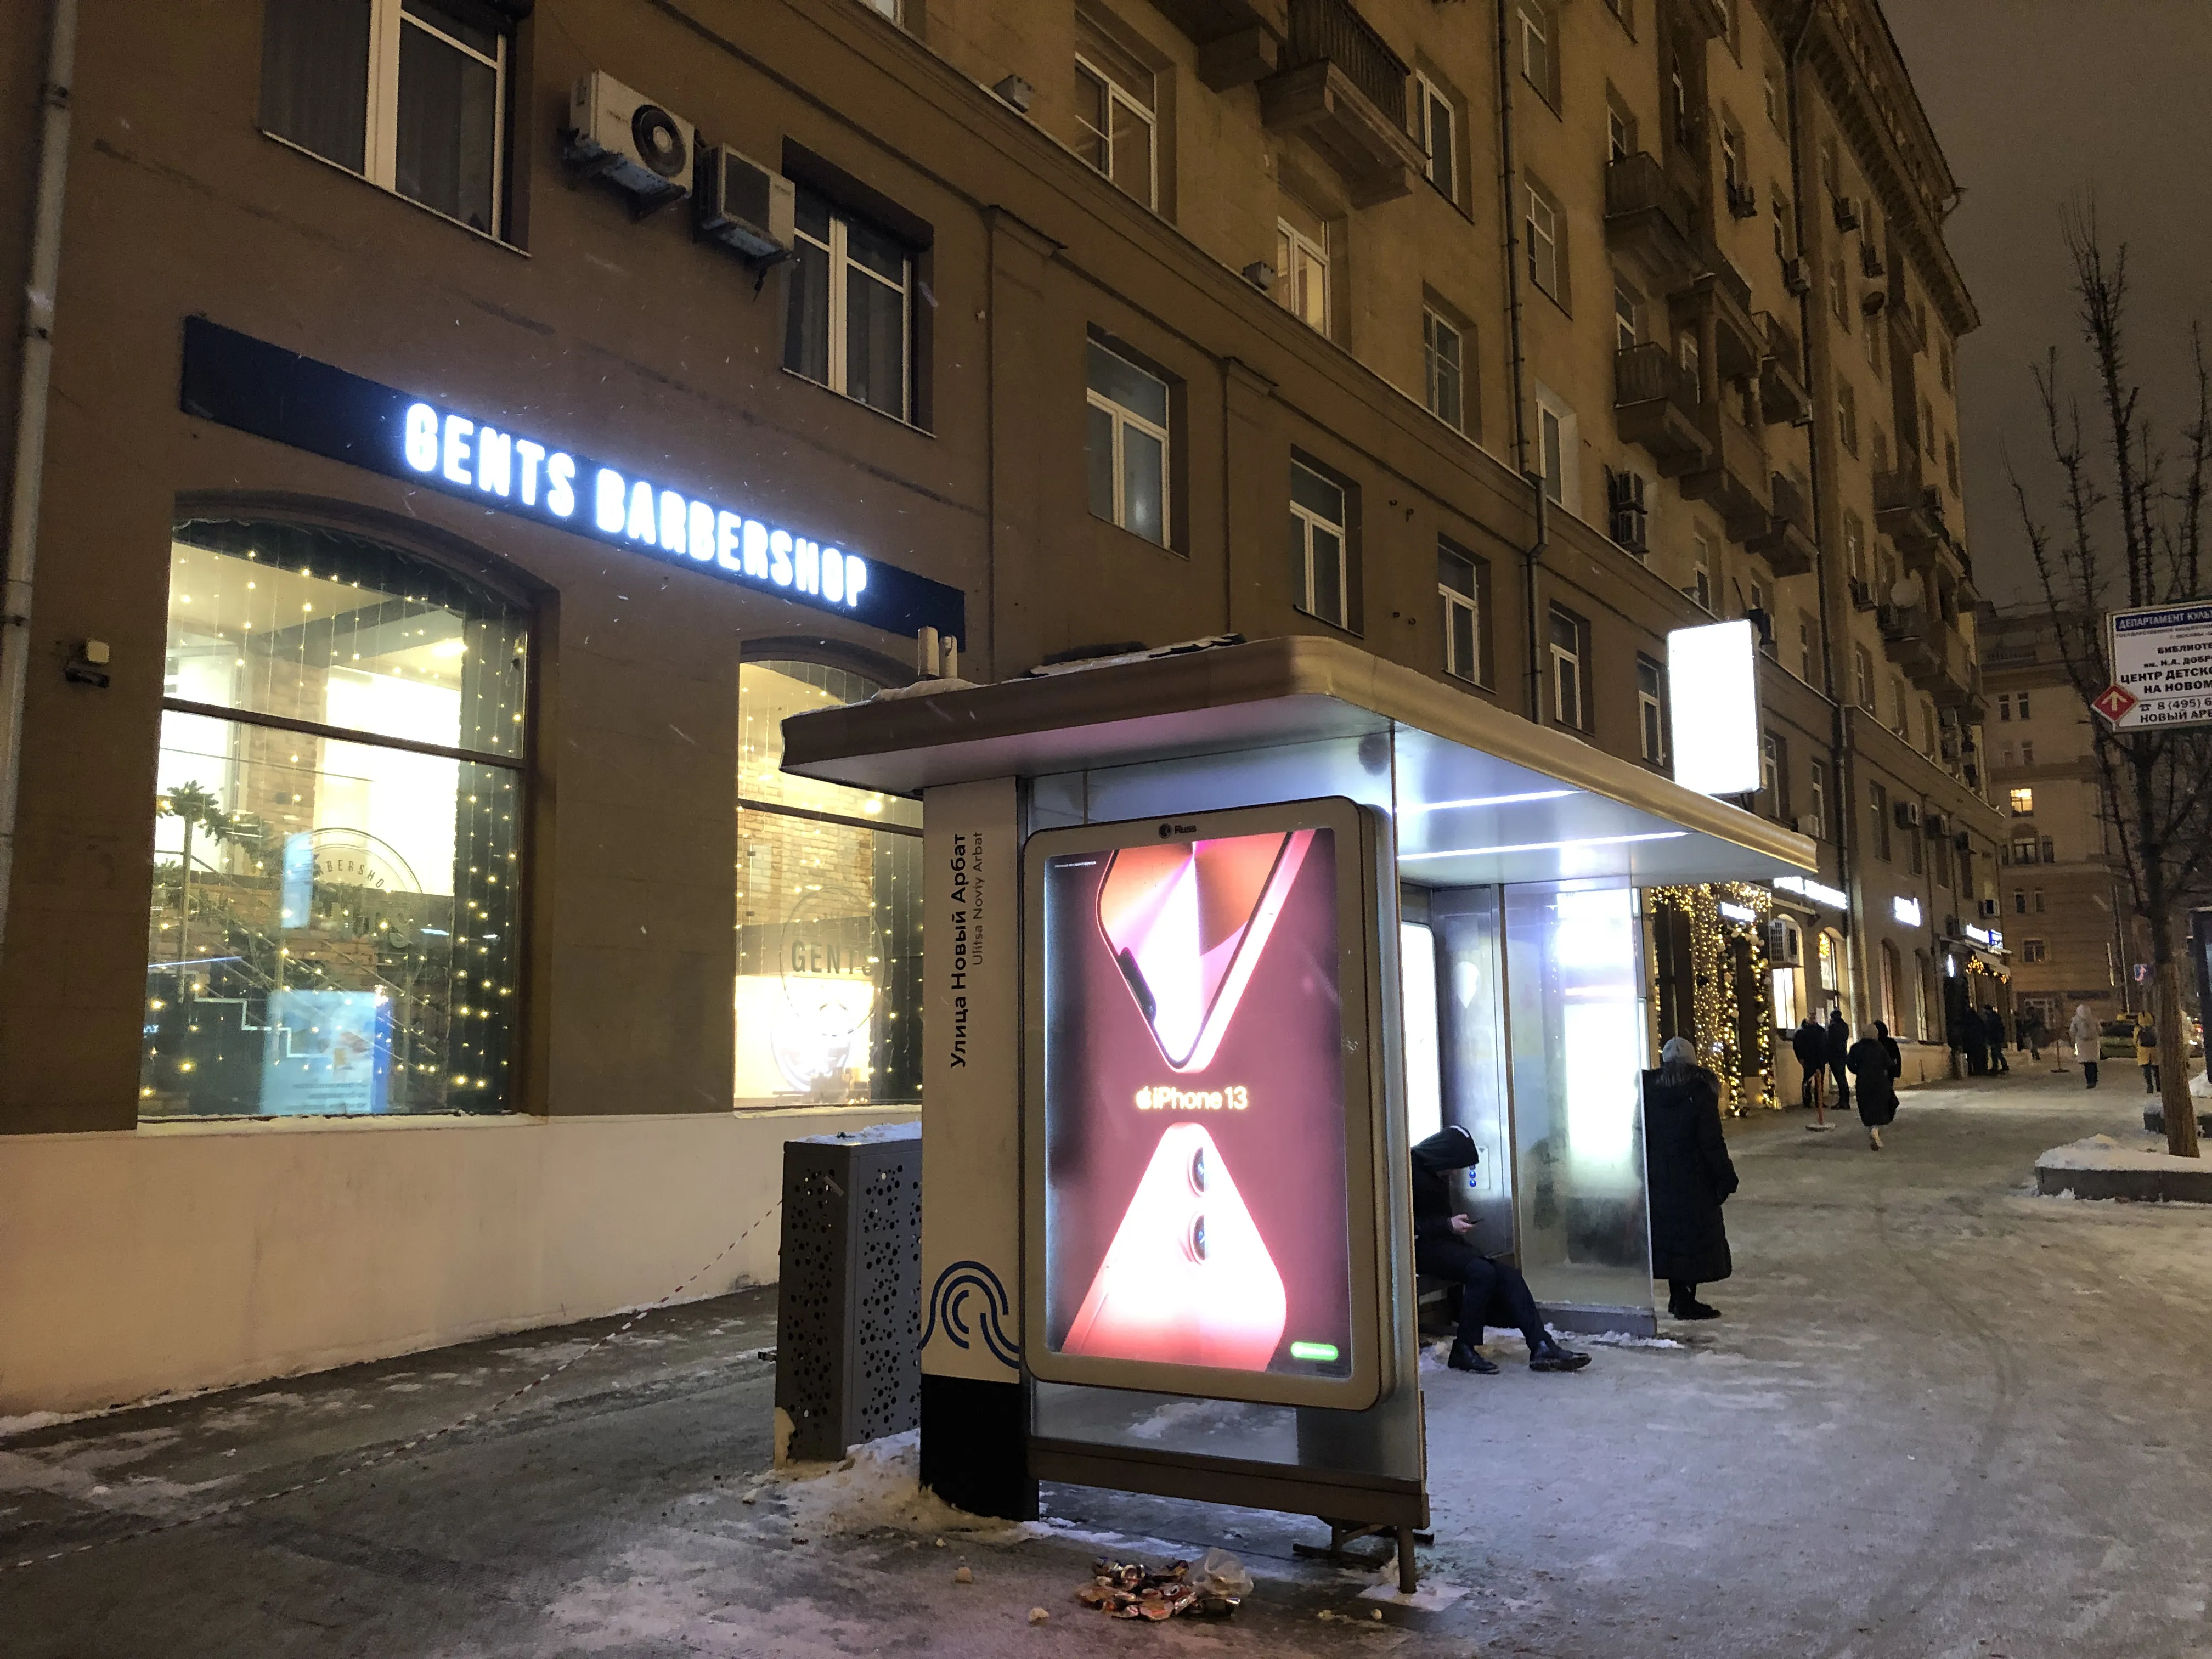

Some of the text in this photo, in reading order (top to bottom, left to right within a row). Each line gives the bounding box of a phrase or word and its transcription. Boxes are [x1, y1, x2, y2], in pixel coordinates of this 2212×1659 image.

[405, 403, 867, 607] GENTS BARBERSHOP
[2119, 613, 2185, 629] ДЕПАРТАМЕНТ
[2183, 655, 2212, 665] ДОБР
[2120, 672, 2162, 684] ЦЕНТР
[2143, 680, 2212, 693] НА НОВОМ
[2157, 702, 2165, 710] 8
[2168, 698, 2201, 710] (495)
[2140, 709, 2187, 723] НОВЫЙ
[972, 832, 985, 965] Ulitsa Noviy Arbat
[950, 833, 969, 1068] Улица Новый Арбат
[1153, 1086, 1248, 1109] iPhone 13
